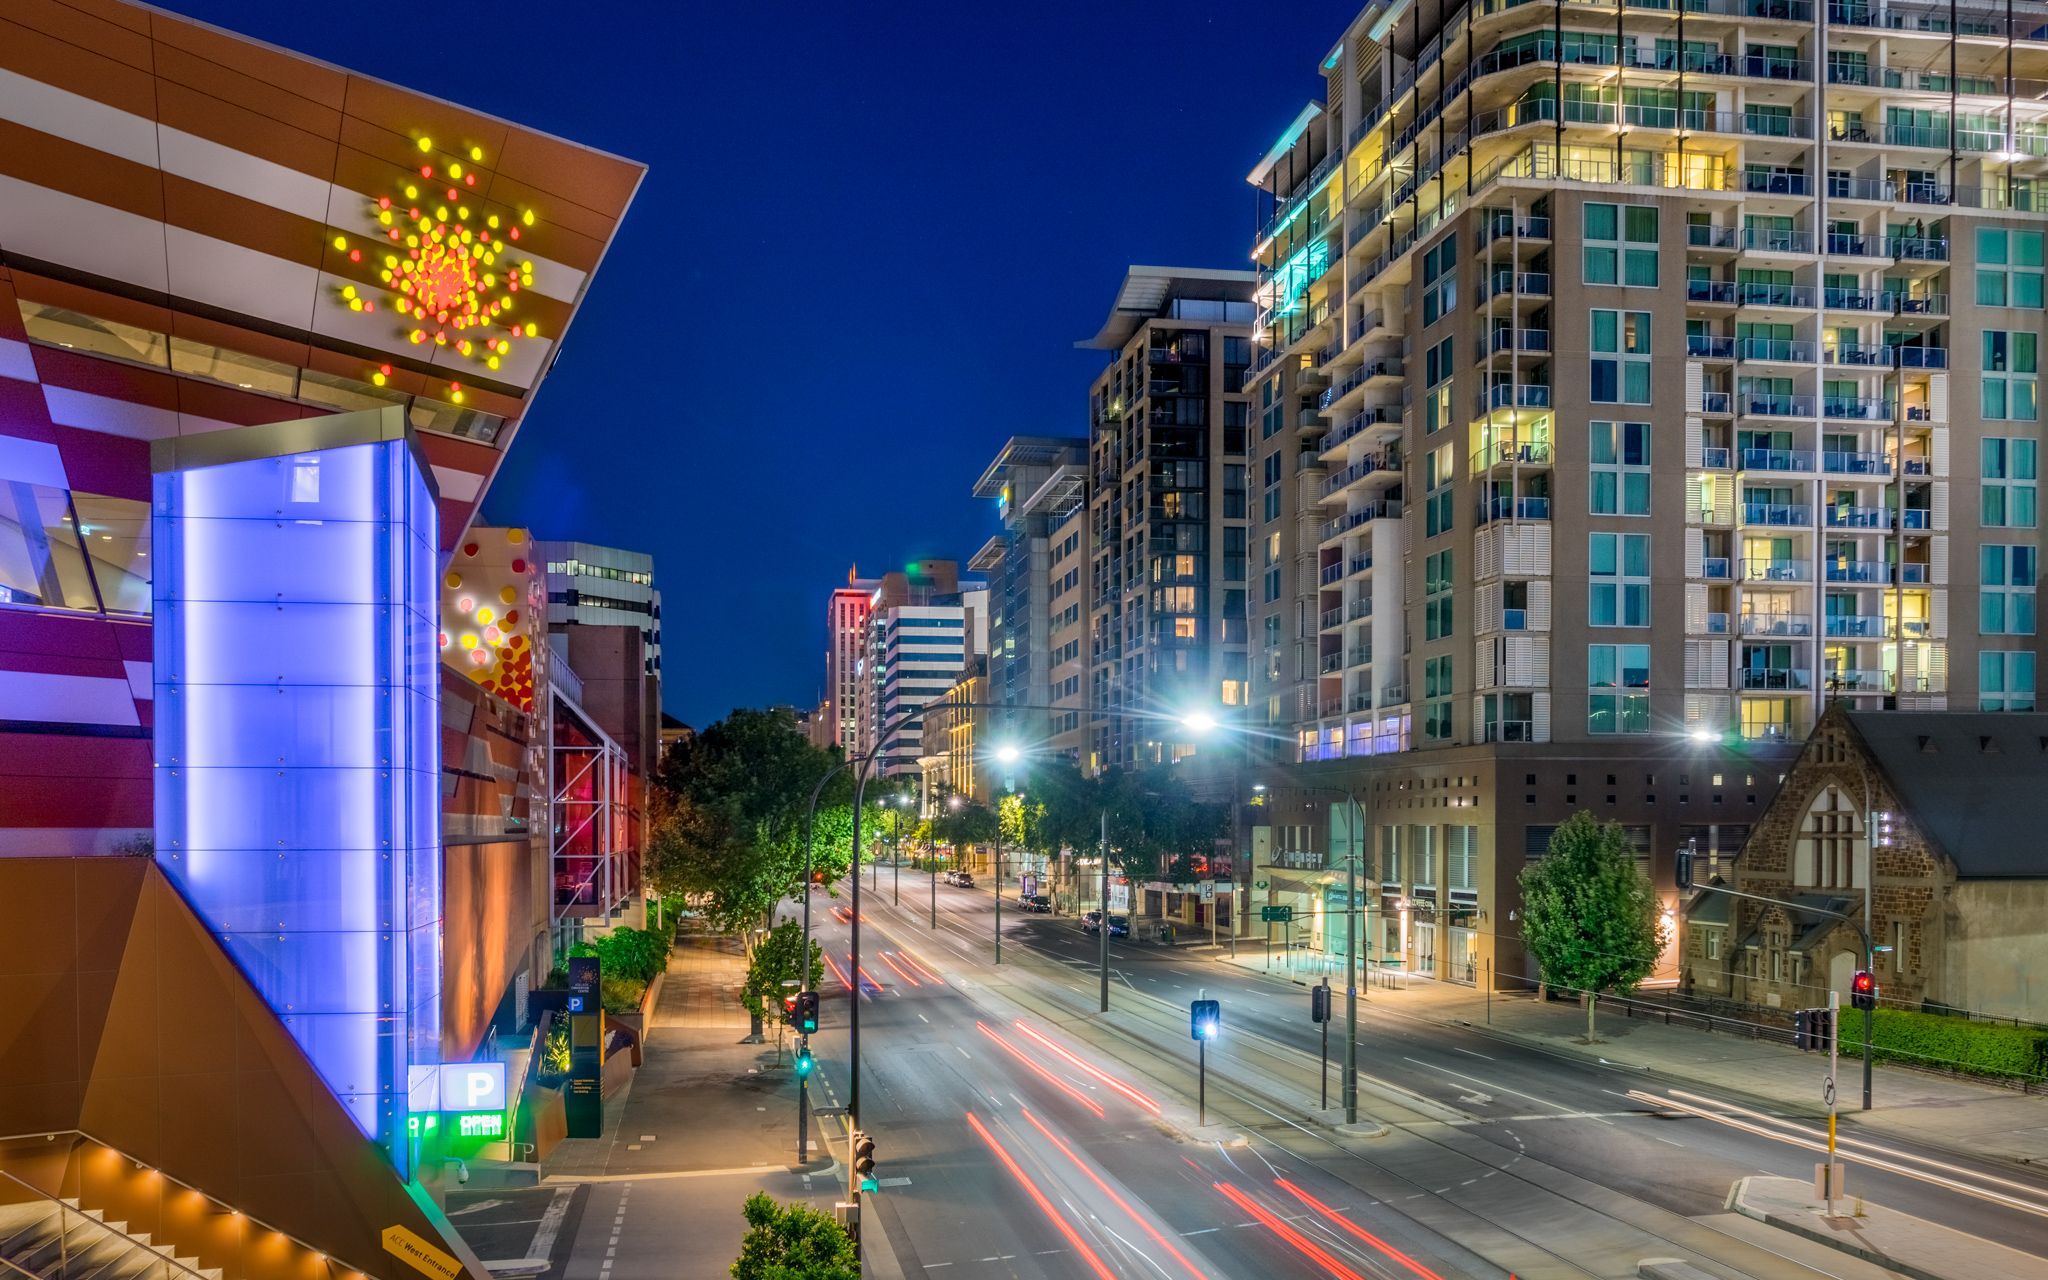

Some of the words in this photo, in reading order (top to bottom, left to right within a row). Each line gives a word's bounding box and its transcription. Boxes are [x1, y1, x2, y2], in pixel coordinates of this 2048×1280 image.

[571, 998, 580, 1010] P
[467, 1072, 495, 1107] P
[460, 1115, 502, 1136] OPEN
[404, 1242, 423, 1260] West
[422, 1254, 456, 1279] Entrance
